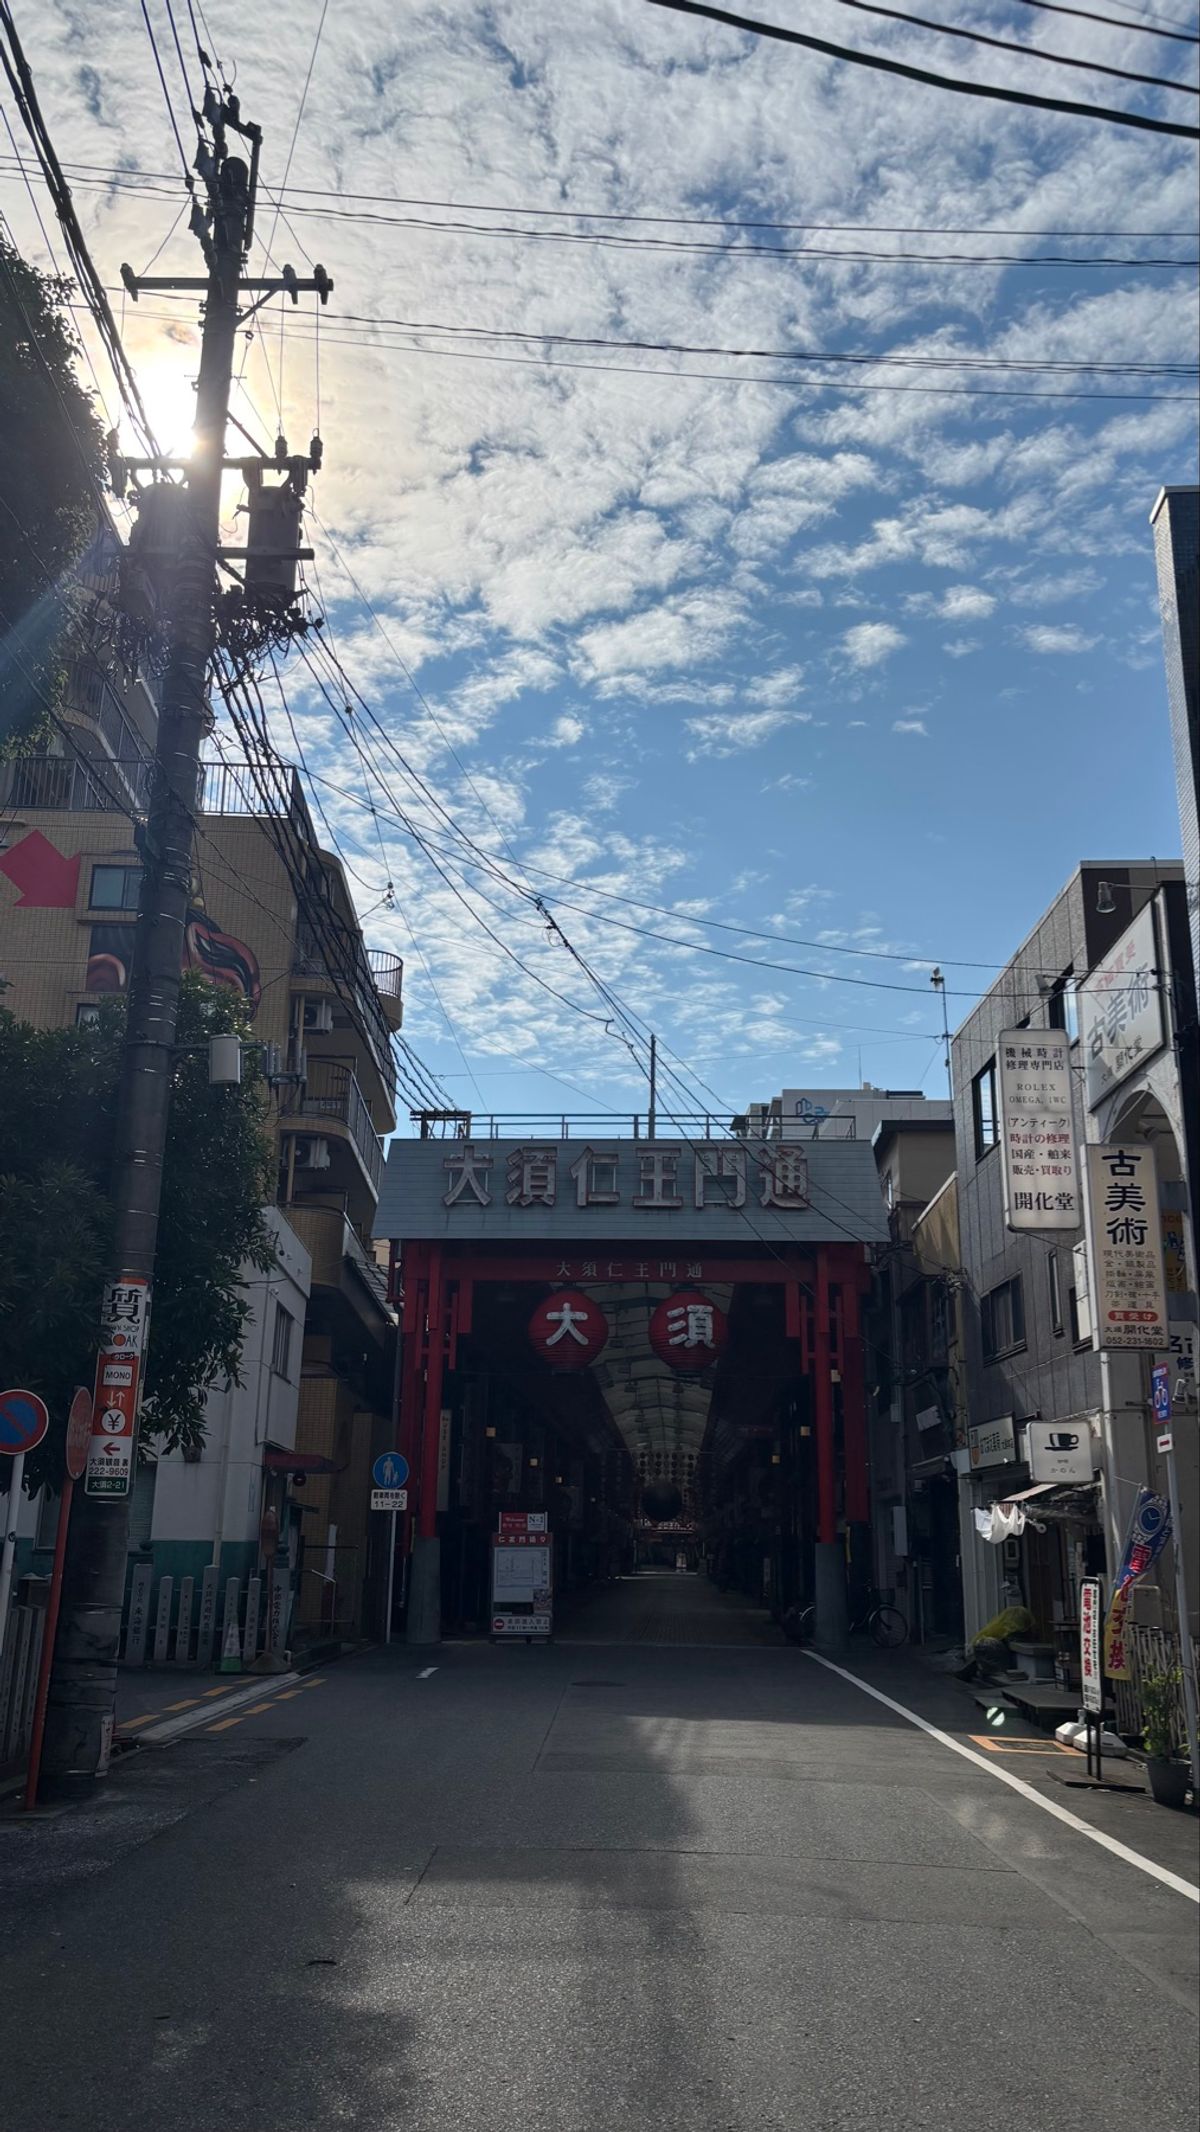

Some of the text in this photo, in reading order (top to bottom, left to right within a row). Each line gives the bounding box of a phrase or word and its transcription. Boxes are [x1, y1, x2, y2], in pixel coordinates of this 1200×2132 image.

[1086, 962, 1149, 1060] 古美術
[1005, 1047, 1064, 1058] 機械時計
[1005, 1059, 1065, 1071] 修理専門店
[1016, 1083, 1056, 1092] ROLEX
[1048, 1096, 1067, 1105] IWC
[1009, 1133, 1071, 1145] 時計の修理
[1011, 1148, 1072, 1160] 国産・舶来
[1012, 1164, 1072, 1176] 販売・買取り
[443, 1144, 811, 1209] 大須仁王門通
[1014, 1191, 1075, 1211] 開化堂
[1101, 1149, 1149, 1245] 古美術
[555, 1260, 703, 1278] 大須仁王門通
[107, 1287, 142, 1324] 質
[545, 1302, 589, 1346] 大
[666, 1304, 716, 1349] 須
[1123, 1324, 1164, 1336] 開化堂
[105, 1370, 131, 1380] MONO
[88, 1467, 129, 1476] 222-9609
[374, 1500, 404, 1508] 11-22
